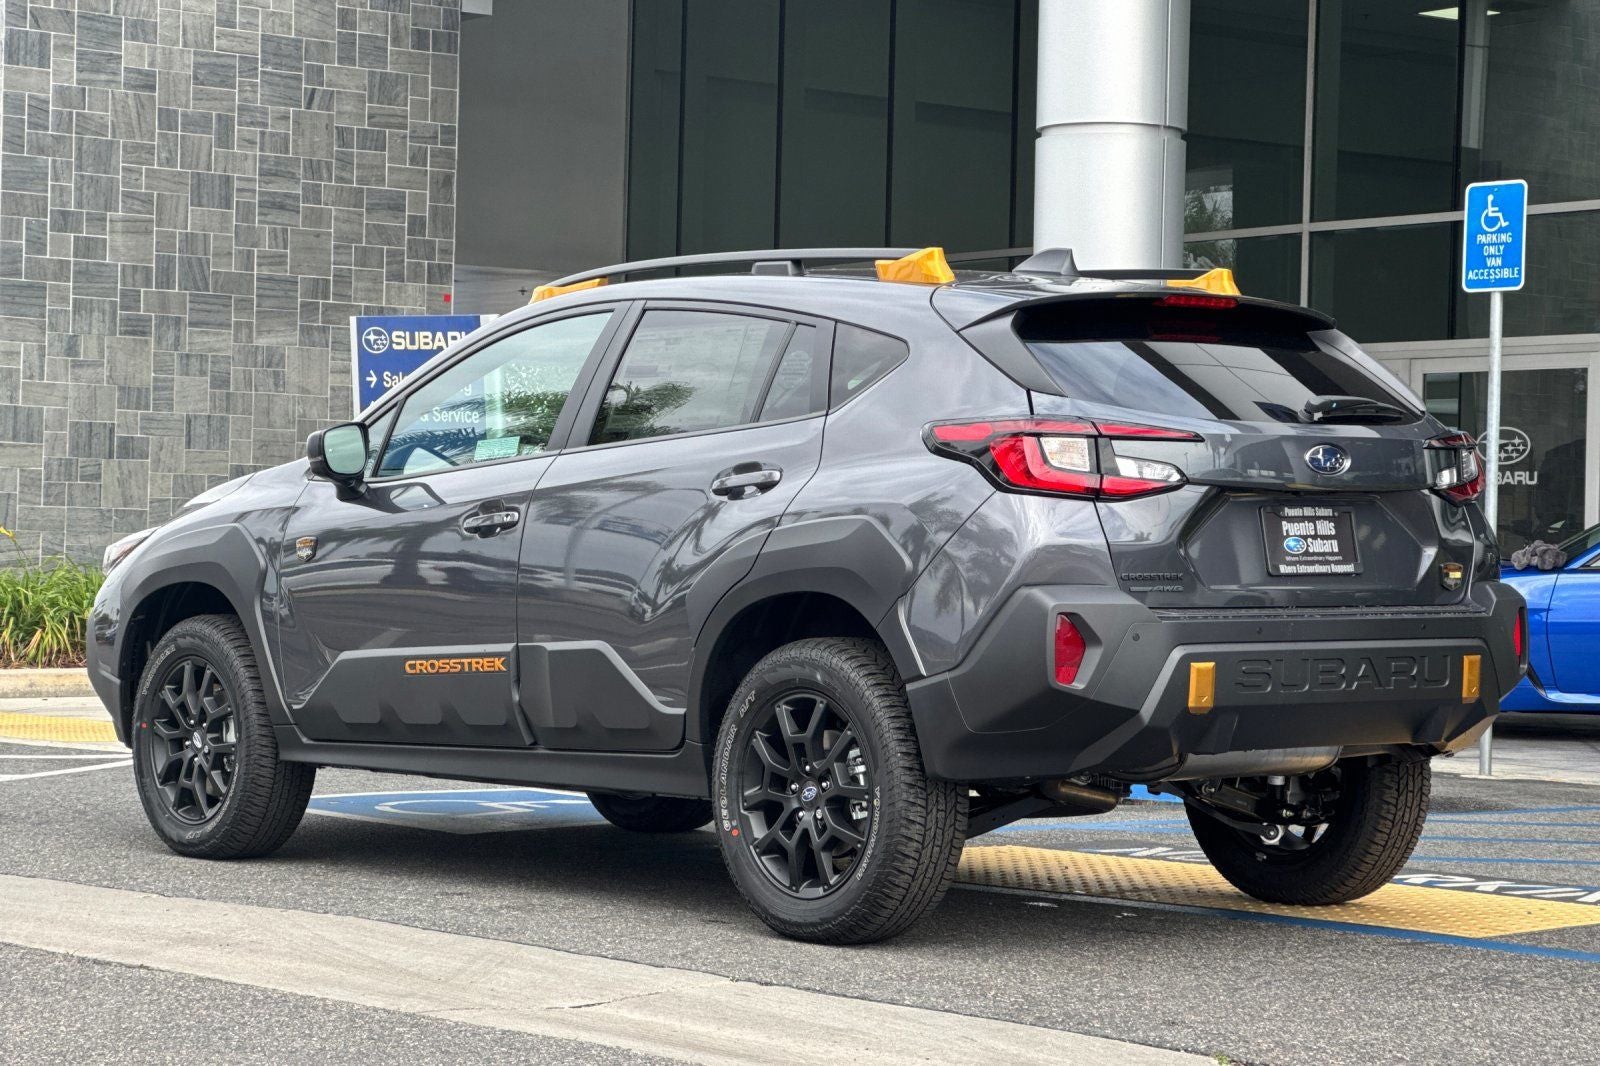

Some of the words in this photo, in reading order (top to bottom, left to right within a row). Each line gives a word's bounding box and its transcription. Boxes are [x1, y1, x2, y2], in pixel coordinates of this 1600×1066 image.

[1476, 232, 1513, 245] PARKING
[1483, 245, 1505, 256] ONLY
[1486, 256, 1502, 268] VAN
[1467, 267, 1520, 280] ACCESSIBLE
[391, 331, 465, 350] SUBAR
[383, 371, 408, 388] Sal
[432, 407, 480, 423] Service
[1497, 470, 1538, 485] ARU
[1284, 507, 1303, 517] Puente
[1315, 507, 1333, 516] Subaru
[1281, 520, 1315, 535] Puente
[1315, 520, 1336, 535] Hills
[1307, 538, 1339, 552] Subaru
[1279, 564, 1296, 573] Where
[1296, 564, 1331, 573] Extraordinary
[1121, 573, 1184, 581] CROSSTREK
[404, 657, 507, 674] CROSSTREK
[1235, 654, 1450, 694] SUBARU
